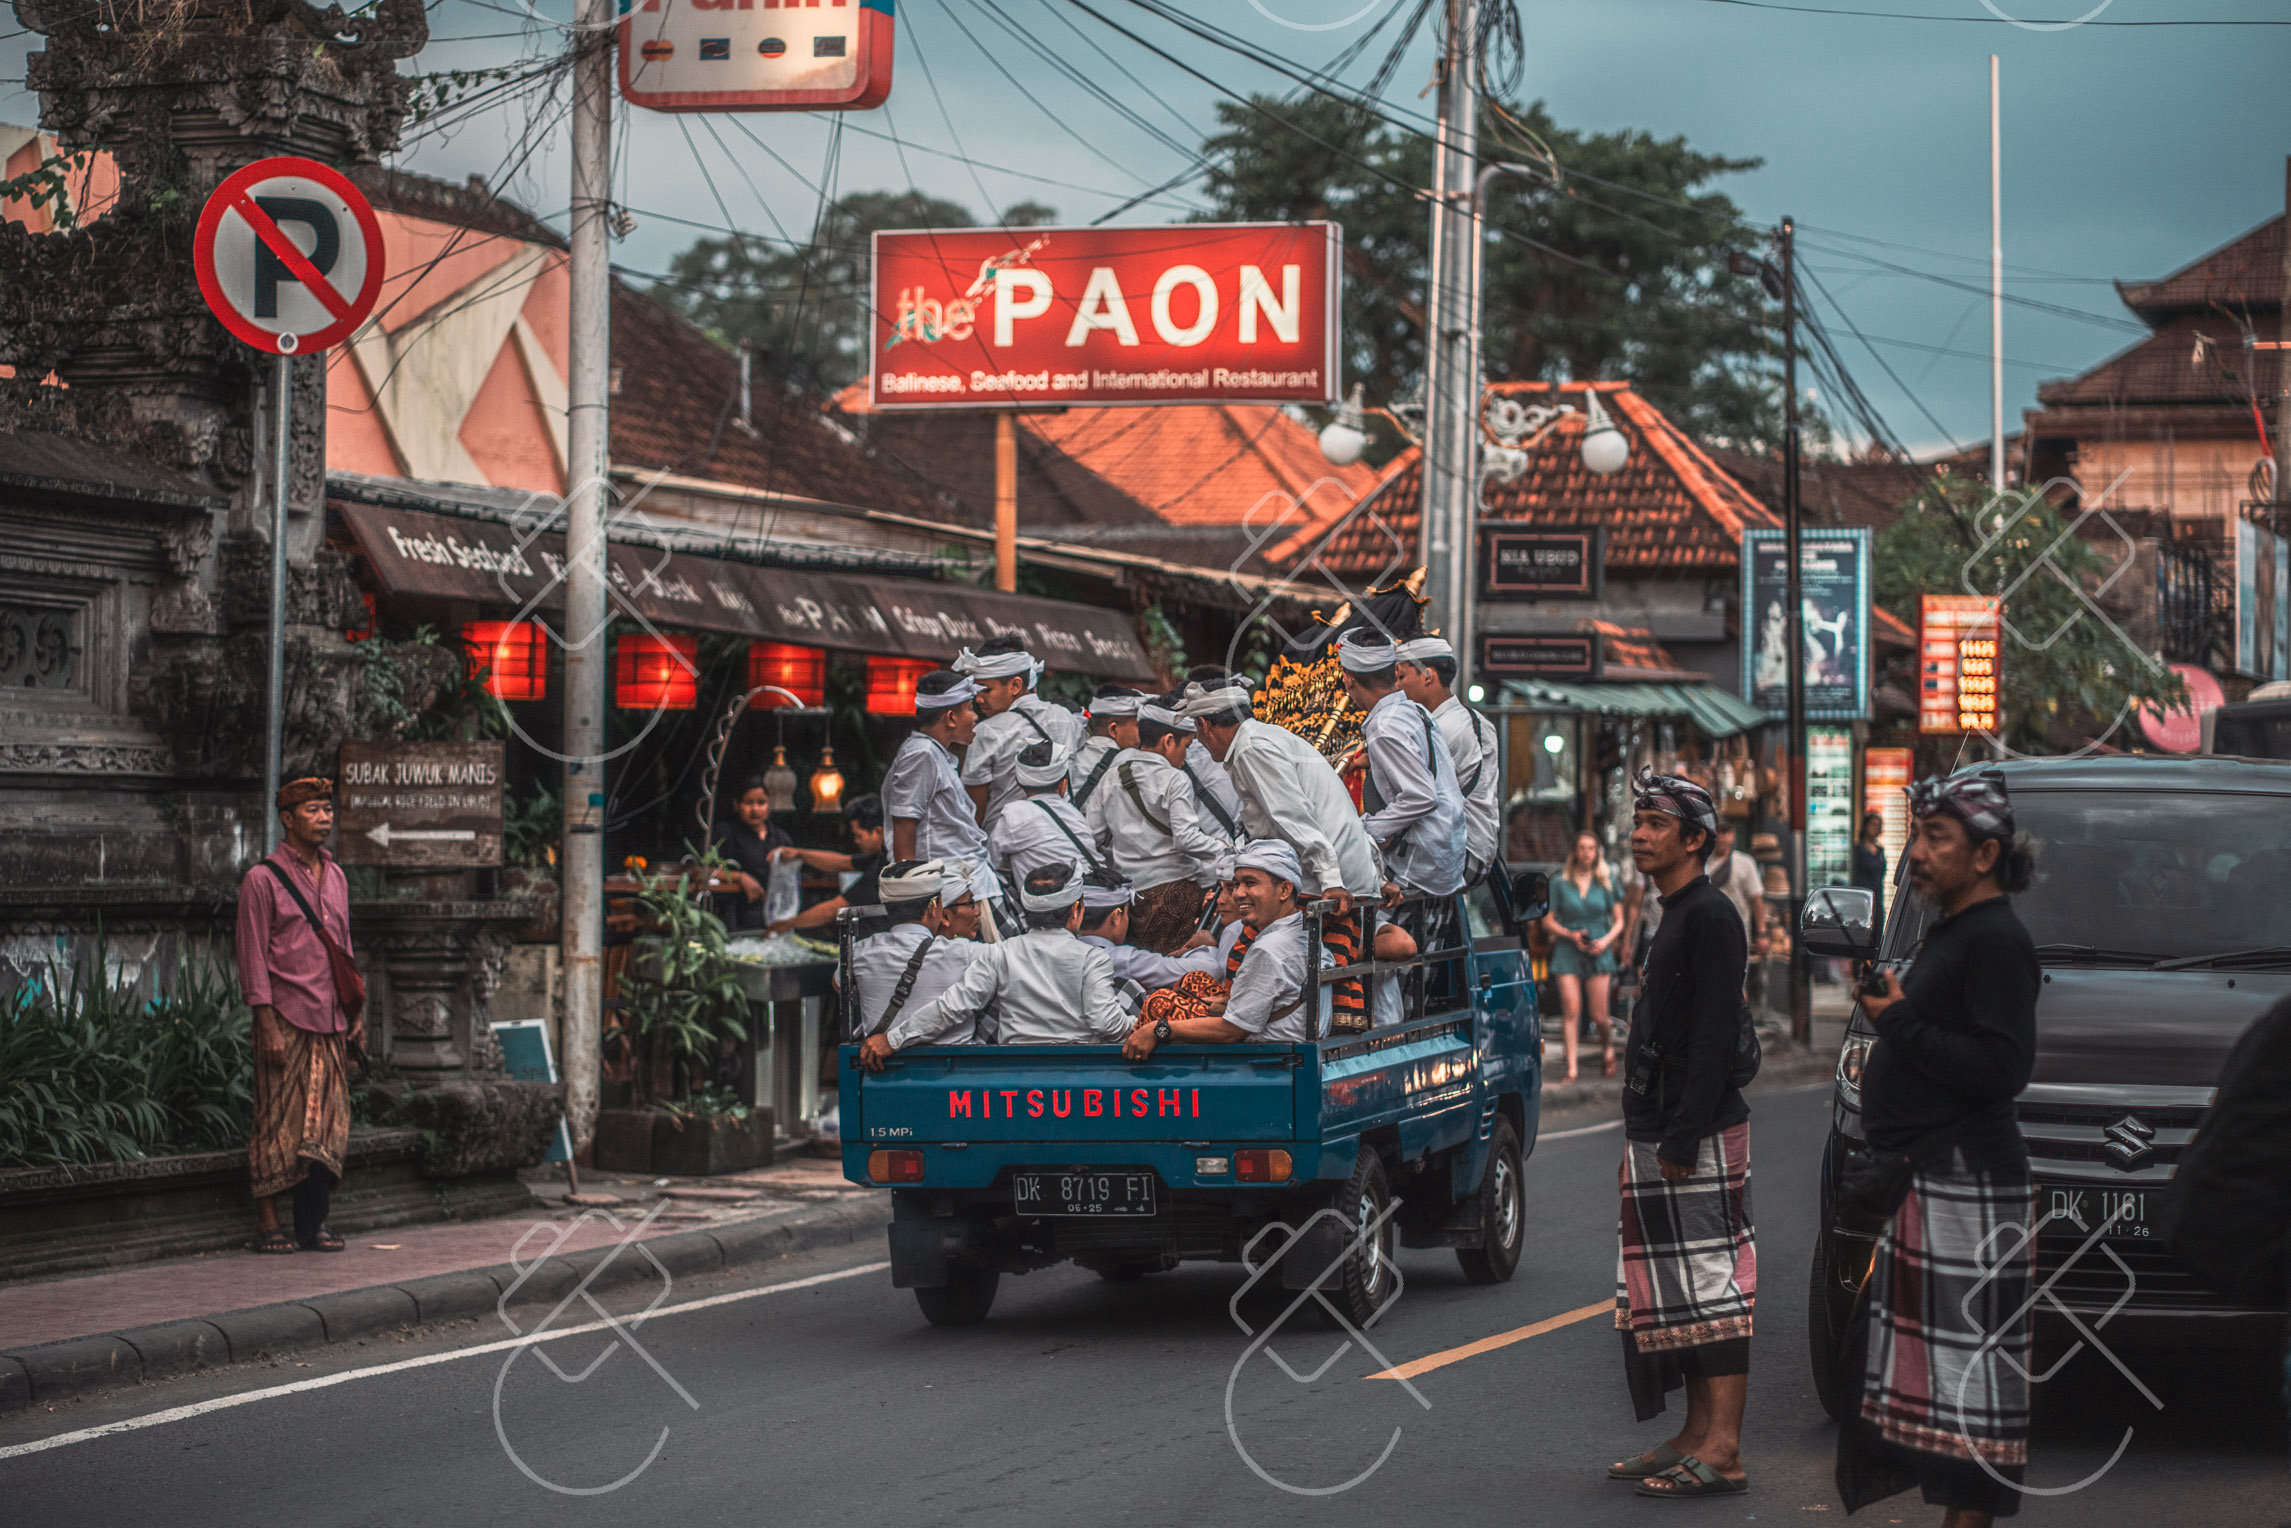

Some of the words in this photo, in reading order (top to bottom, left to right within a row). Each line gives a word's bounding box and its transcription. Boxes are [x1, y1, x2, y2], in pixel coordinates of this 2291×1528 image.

[896, 286, 975, 342] the
[993, 263, 1301, 348] PAON
[881, 372, 966, 394] Balinese,
[970, 369, 1049, 391] Seafood
[1051, 369, 1089, 390] and
[1092, 368, 1210, 389] International
[1212, 367, 1318, 388] Restaurant
[386, 526, 455, 565] Fresh
[345, 762, 390, 785] SUBAK
[394, 762, 443, 785] JUWUK
[447, 762, 497, 785] MANIS
[949, 1088, 1199, 1118] MITSUBISHI
[889, 1127, 913, 1137] MPi
[1017, 1177, 1041, 1200] DK
[1061, 1177, 1110, 1200] 8719
[1126, 1177, 1150, 1200] FI
[2051, 1190, 2083, 1219] DK
